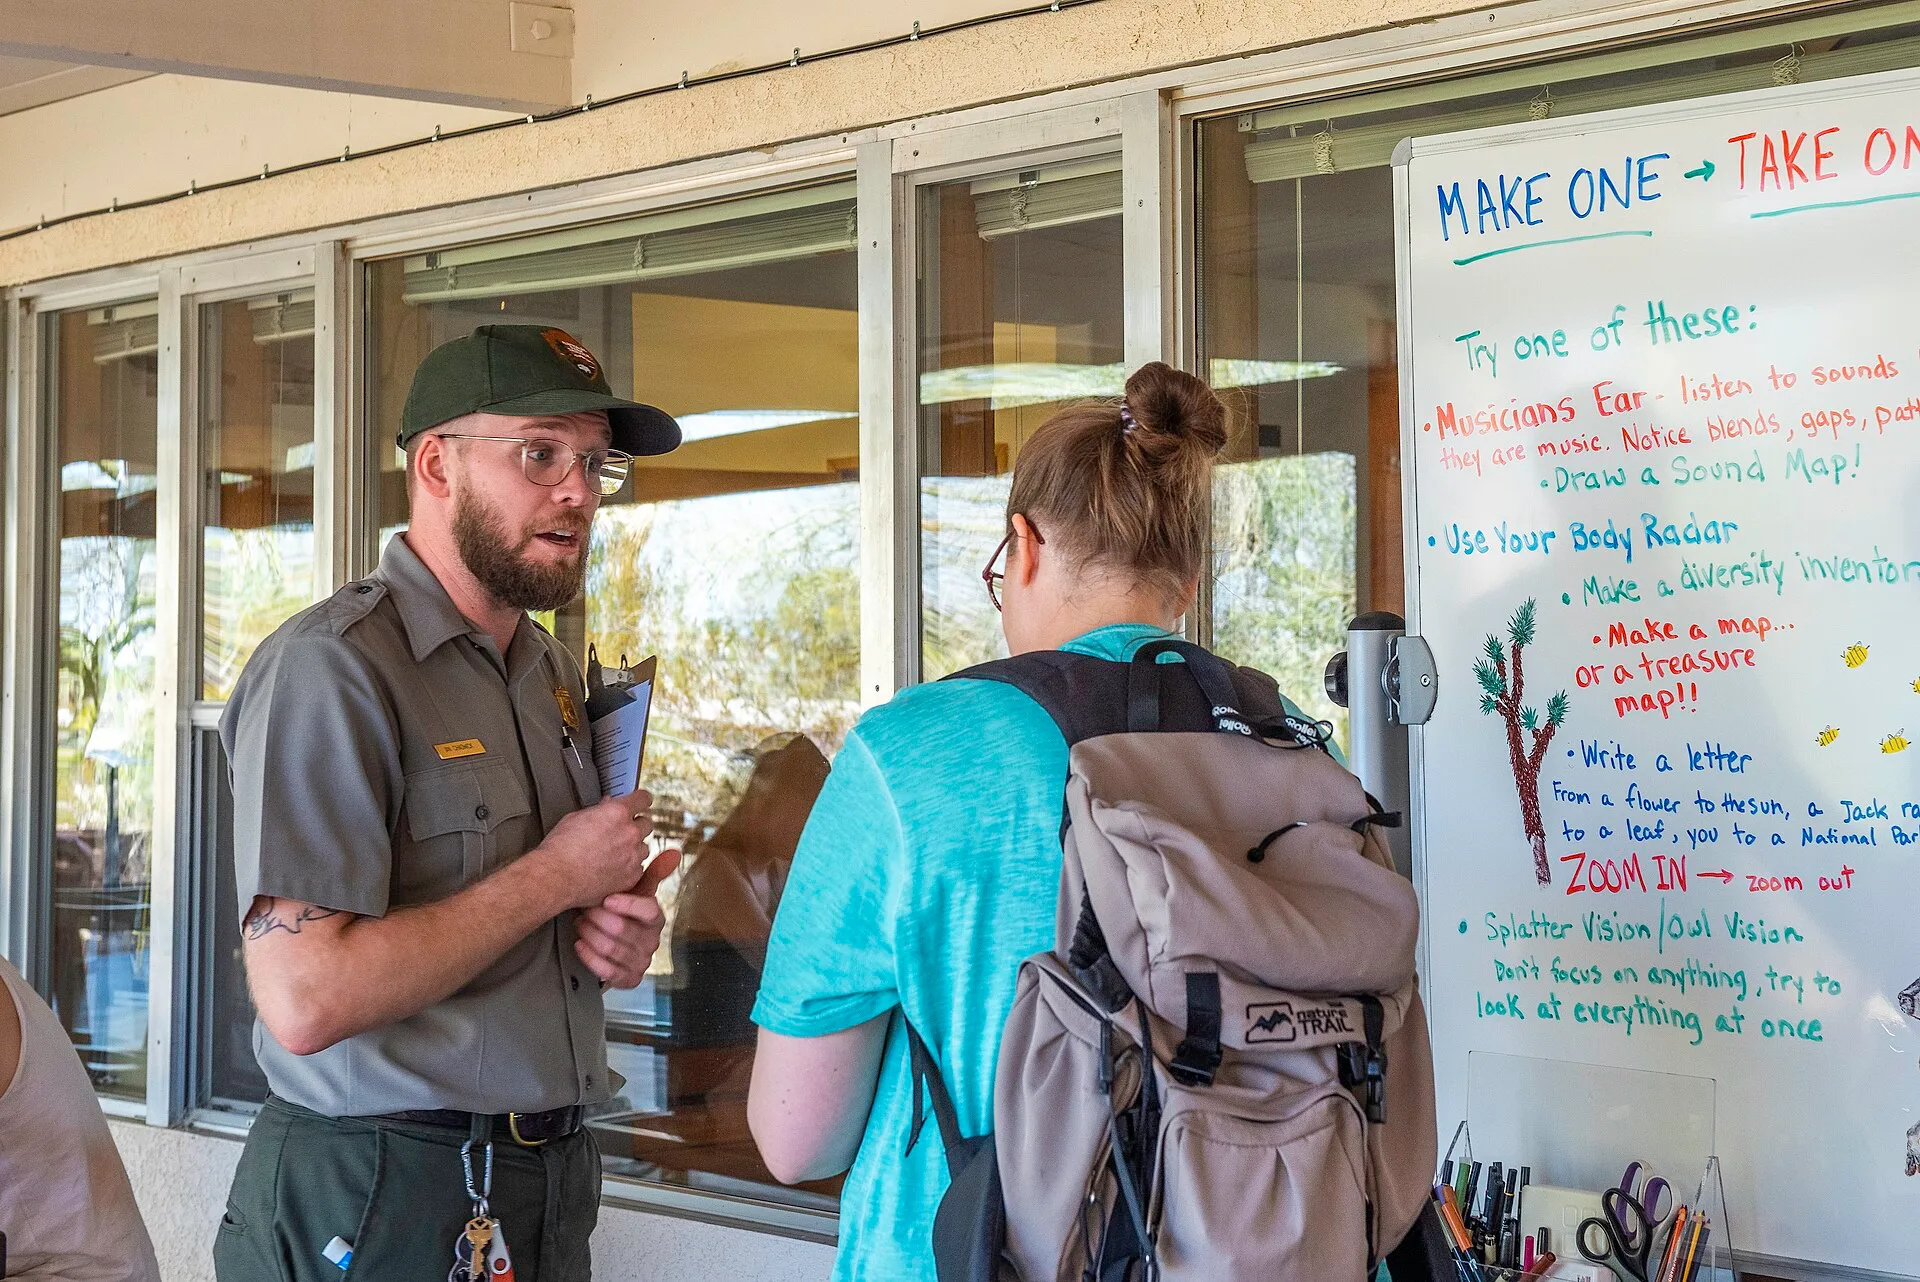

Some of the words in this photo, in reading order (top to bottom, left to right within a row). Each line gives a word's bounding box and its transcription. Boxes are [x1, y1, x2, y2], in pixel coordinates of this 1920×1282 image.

[1436, 171, 1552, 242] MAKE
[1568, 152, 1671, 220] ONE
[1727, 126, 1840, 192] TAKE
[1454, 330, 1496, 378] Try
[1514, 329, 1569, 360] one
[1591, 304, 1626, 351] of
[1643, 300, 1757, 345] these:
[1436, 397, 1576, 440] Musicians
[1681, 374, 1752, 404] listen
[1768, 365, 1796, 390] to
[1812, 354, 1898, 385] sounds
[1440, 448, 1481, 477] they
[1492, 445, 1525, 465] are
[1537, 435, 1610, 457] music.
[1621, 423, 1691, 453] Notice
[1801, 409, 1866, 440] gaps,
[1555, 466, 1626, 493] Draw
[1641, 467, 1660, 485] a
[1672, 450, 1765, 485] Sound
[1786, 443, 1860, 485] Map!
[1445, 523, 1489, 555] Use
[1494, 521, 1557, 556] Your
[1569, 519, 1632, 564] Body
[1641, 512, 1738, 549] Radar
[1583, 575, 1641, 607] Make
[1657, 580, 1674, 597] a
[1681, 550, 1784, 596] diversity
[1795, 545, 1920, 584] inventor
[1608, 617, 1679, 649] Make
[1688, 623, 1708, 641] a
[1717, 616, 1795, 643] map...
[1575, 664, 1605, 689] or
[1613, 664, 1633, 685] a
[1638, 648, 1756, 682] treasure
[1212, 706, 1239, 717] Roll
[1613, 681, 1697, 720] map!!
[1219, 718, 1252, 735] Rollei
[1285, 717, 1317, 737] Rollei
[1580, 739, 1637, 772] Write
[1655, 753, 1674, 773] a
[1686, 740, 1753, 774] letter
[1552, 780, 1591, 805] From
[1600, 793, 1615, 807] a
[1624, 782, 1680, 814] flower
[1693, 789, 1716, 815] to
[1807, 801, 1824, 818] a
[1840, 798, 1888, 824] Jack
[1562, 820, 1585, 842] to
[1598, 825, 1614, 840] a
[1686, 827, 1719, 851] you
[1732, 822, 1757, 846] to
[1771, 832, 1785, 847] a
[1801, 826, 1877, 848] National
[1890, 824, 1920, 847] Par
[1559, 851, 1648, 896] ZOOM
[1652, 854, 1687, 893] IN
[1745, 874, 1803, 893] zoom
[1818, 864, 1856, 891] out
[1485, 910, 1573, 947] Splatter
[1724, 911, 1804, 944] Vision
[1494, 956, 1540, 982] Don't
[1550, 956, 1602, 985] focus
[1613, 967, 1638, 983] on
[1764, 965, 1804, 1004] try
[1813, 971, 1841, 995] to
[1297, 1017, 1354, 1035] TRAIL
[1537, 992, 1562, 1021] at
[1574, 995, 1703, 1046] everything
[1715, 1005, 1745, 1034] at
[1761, 1019, 1823, 1042] once
